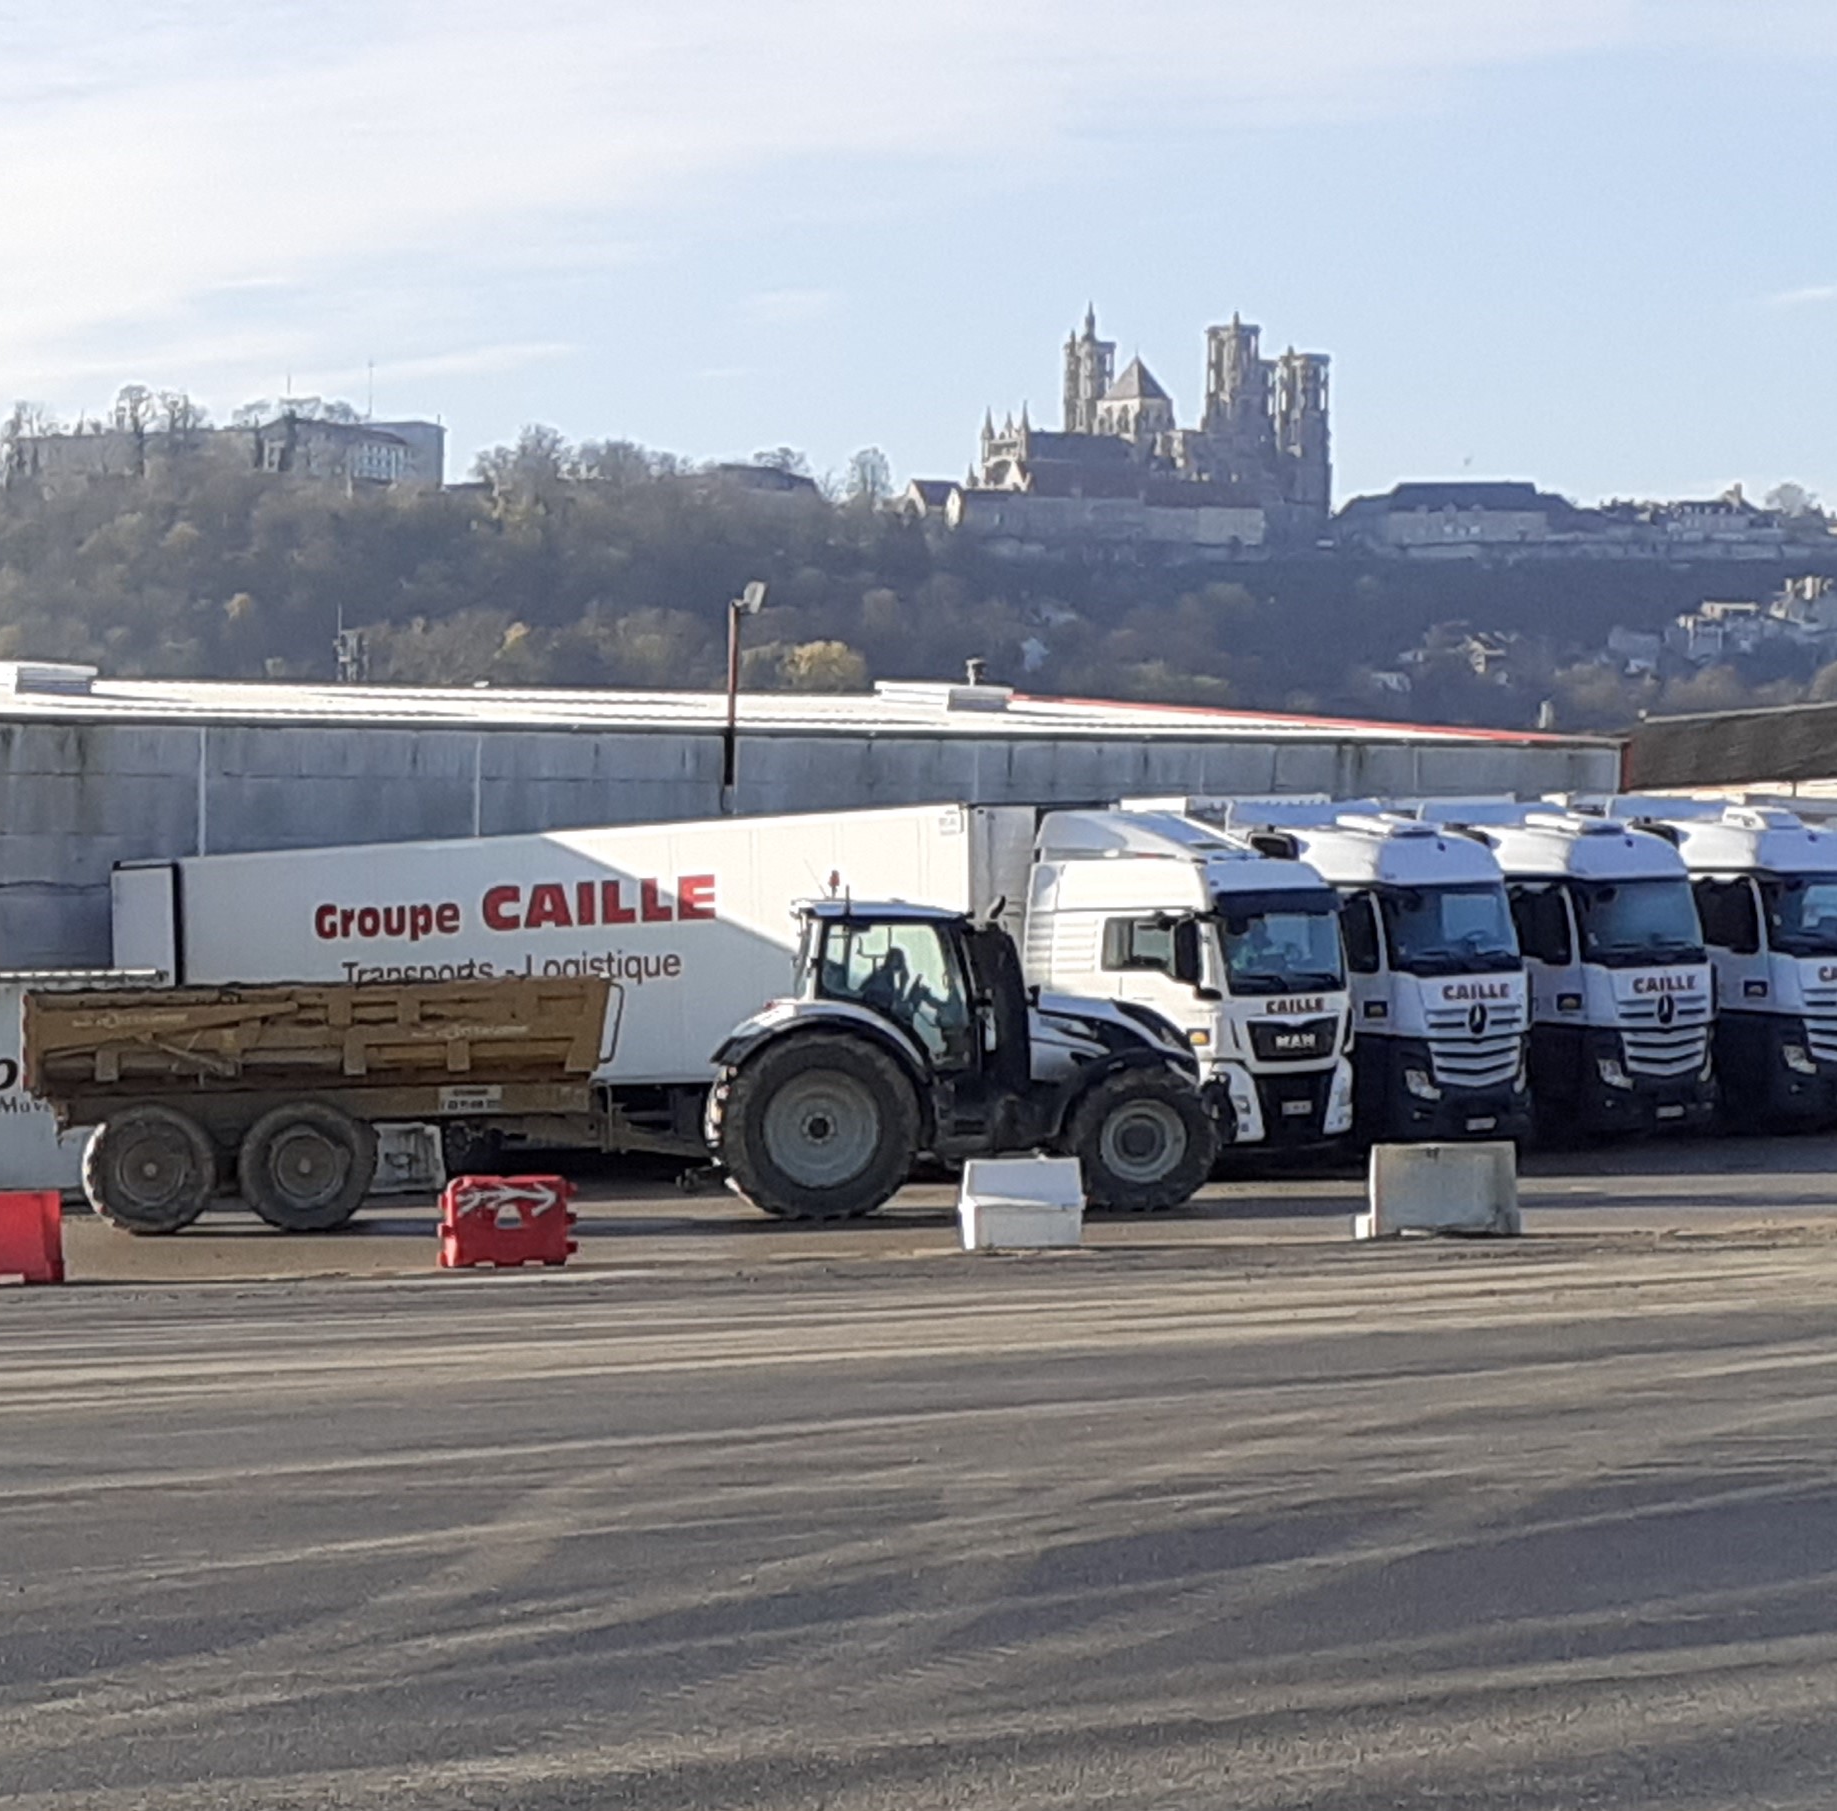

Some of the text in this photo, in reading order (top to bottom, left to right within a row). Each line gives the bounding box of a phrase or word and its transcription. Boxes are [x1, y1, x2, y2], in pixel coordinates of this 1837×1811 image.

[314, 874, 716, 941] Groupe CAILLE
[1442, 983, 1510, 1001] CAILLE
[1632, 975, 1696, 994] CAILLE
[1266, 997, 1324, 1014] CAILLE
[1275, 1033, 1316, 1049] MAN
